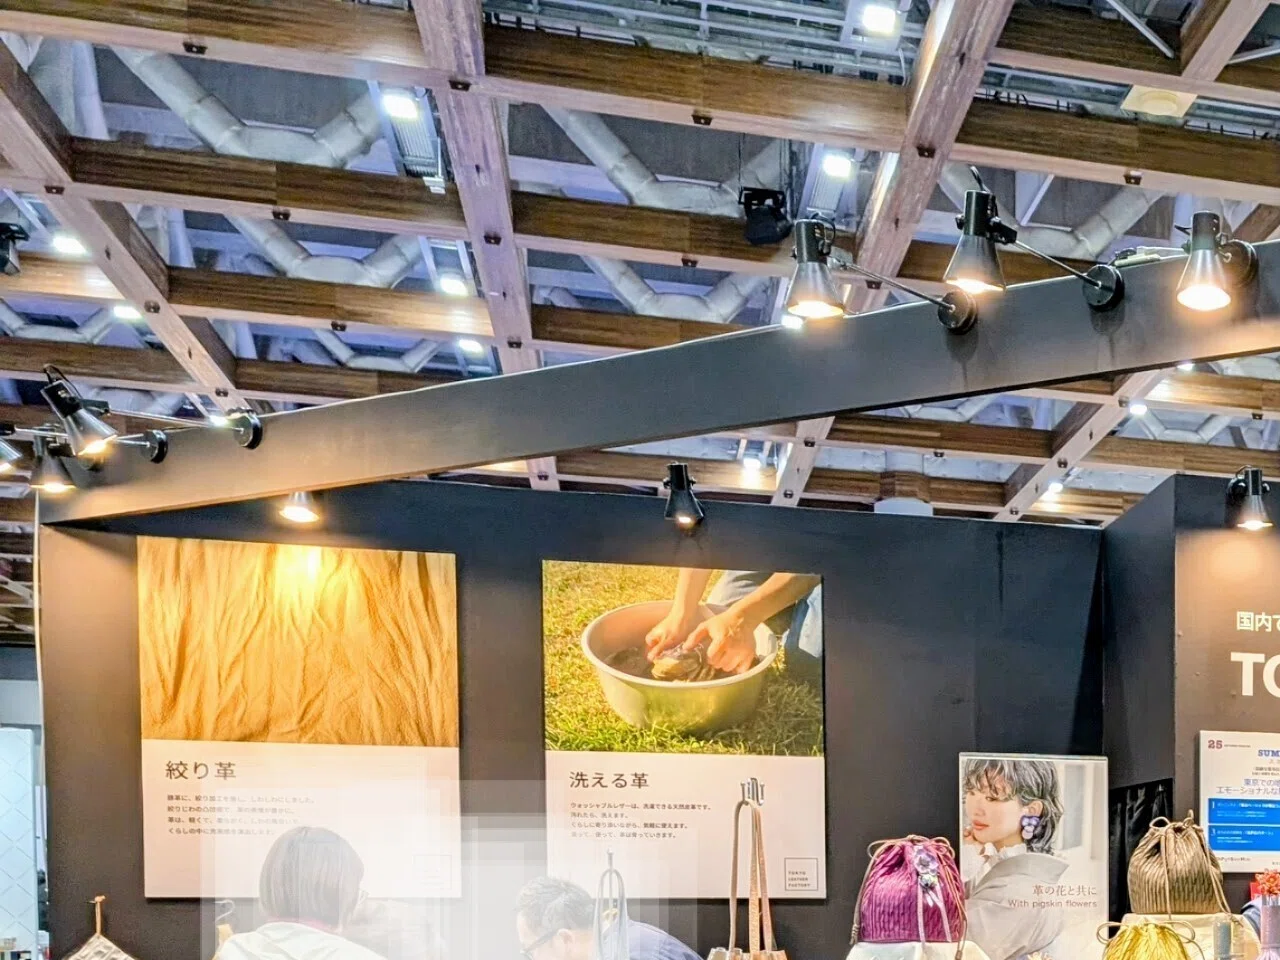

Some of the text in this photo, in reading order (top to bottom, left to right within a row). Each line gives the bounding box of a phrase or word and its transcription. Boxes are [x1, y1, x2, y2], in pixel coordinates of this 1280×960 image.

[1207, 739, 1223, 749] 25
[165, 760, 237, 781] 絞り革
[569, 771, 649, 789] 洗える革
[1032, 885, 1097, 896] 革の花と共に
[1008, 899, 1097, 909] With pigskin flowers
